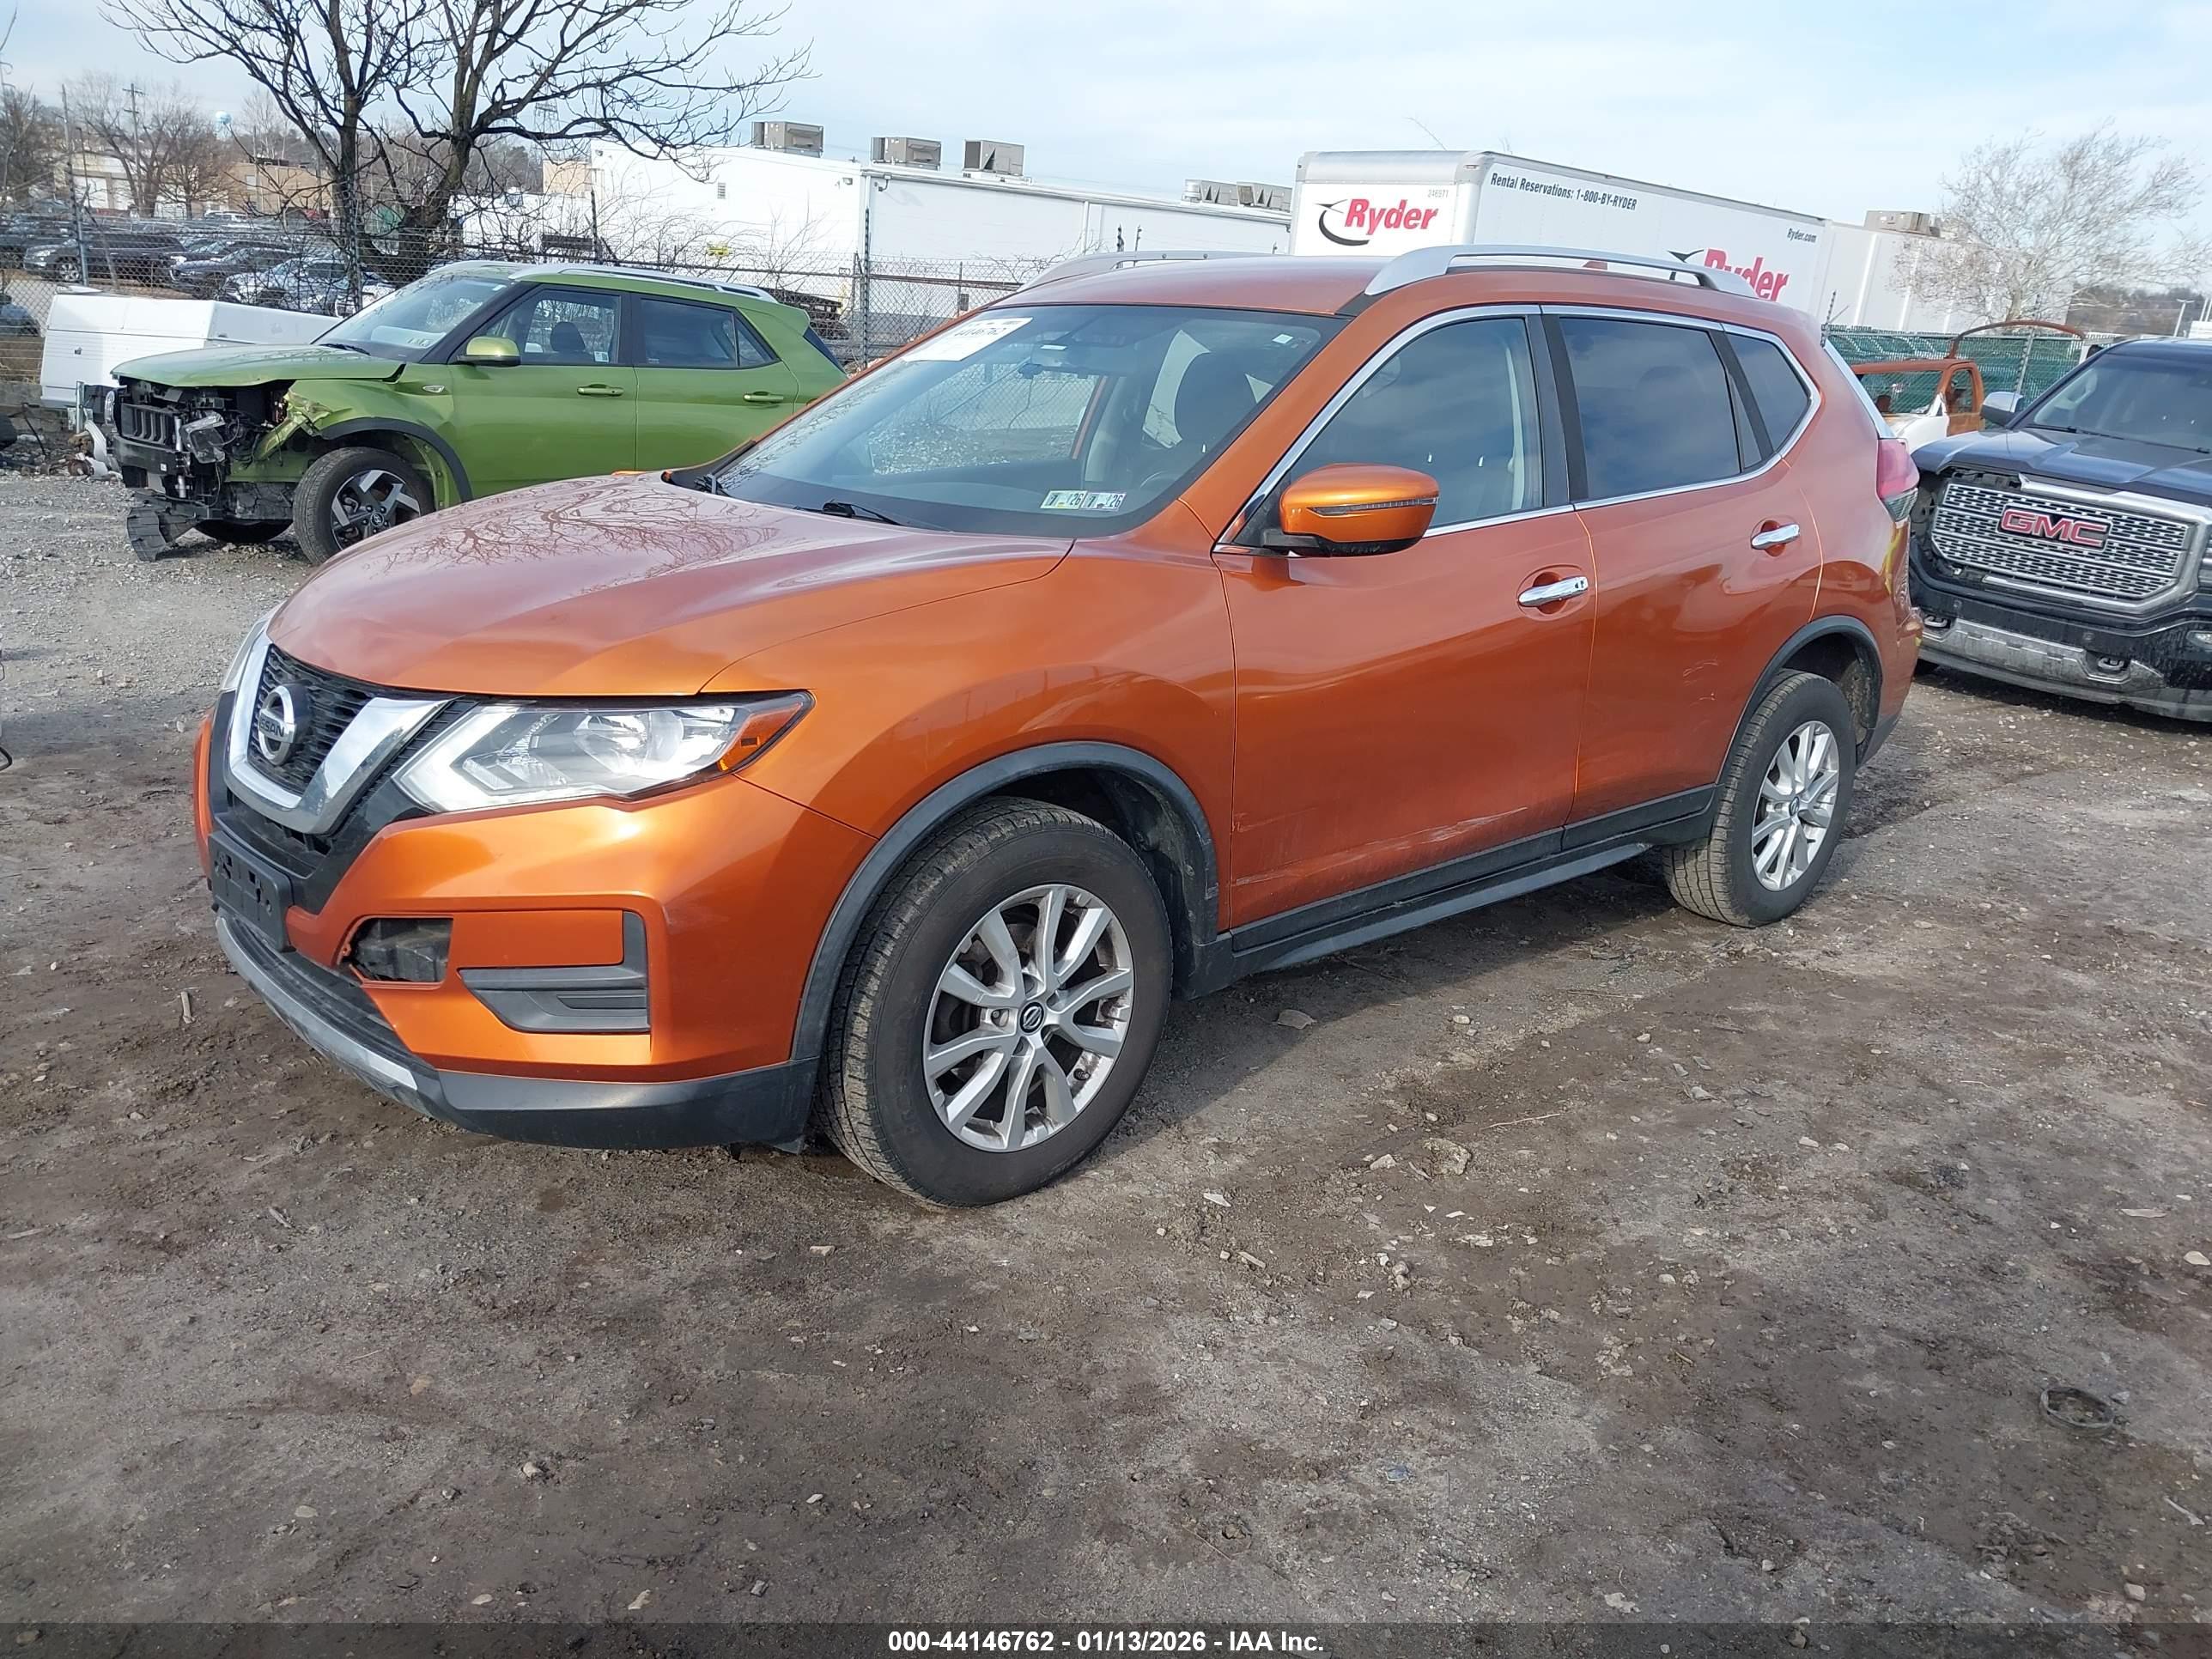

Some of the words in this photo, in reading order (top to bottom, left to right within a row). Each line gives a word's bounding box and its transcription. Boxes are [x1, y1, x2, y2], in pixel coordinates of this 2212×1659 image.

[1490, 173, 1519, 190] Rental
[1519, 178, 1575, 199] Reservations:
[1575, 188, 1638, 211] 1-800-BY-RYDER
[1345, 198, 1439, 236] Ryder
[1786, 228, 1817, 245] Ryder.com
[1705, 247, 1790, 301] Rder
[2001, 508, 2108, 548] GMC
